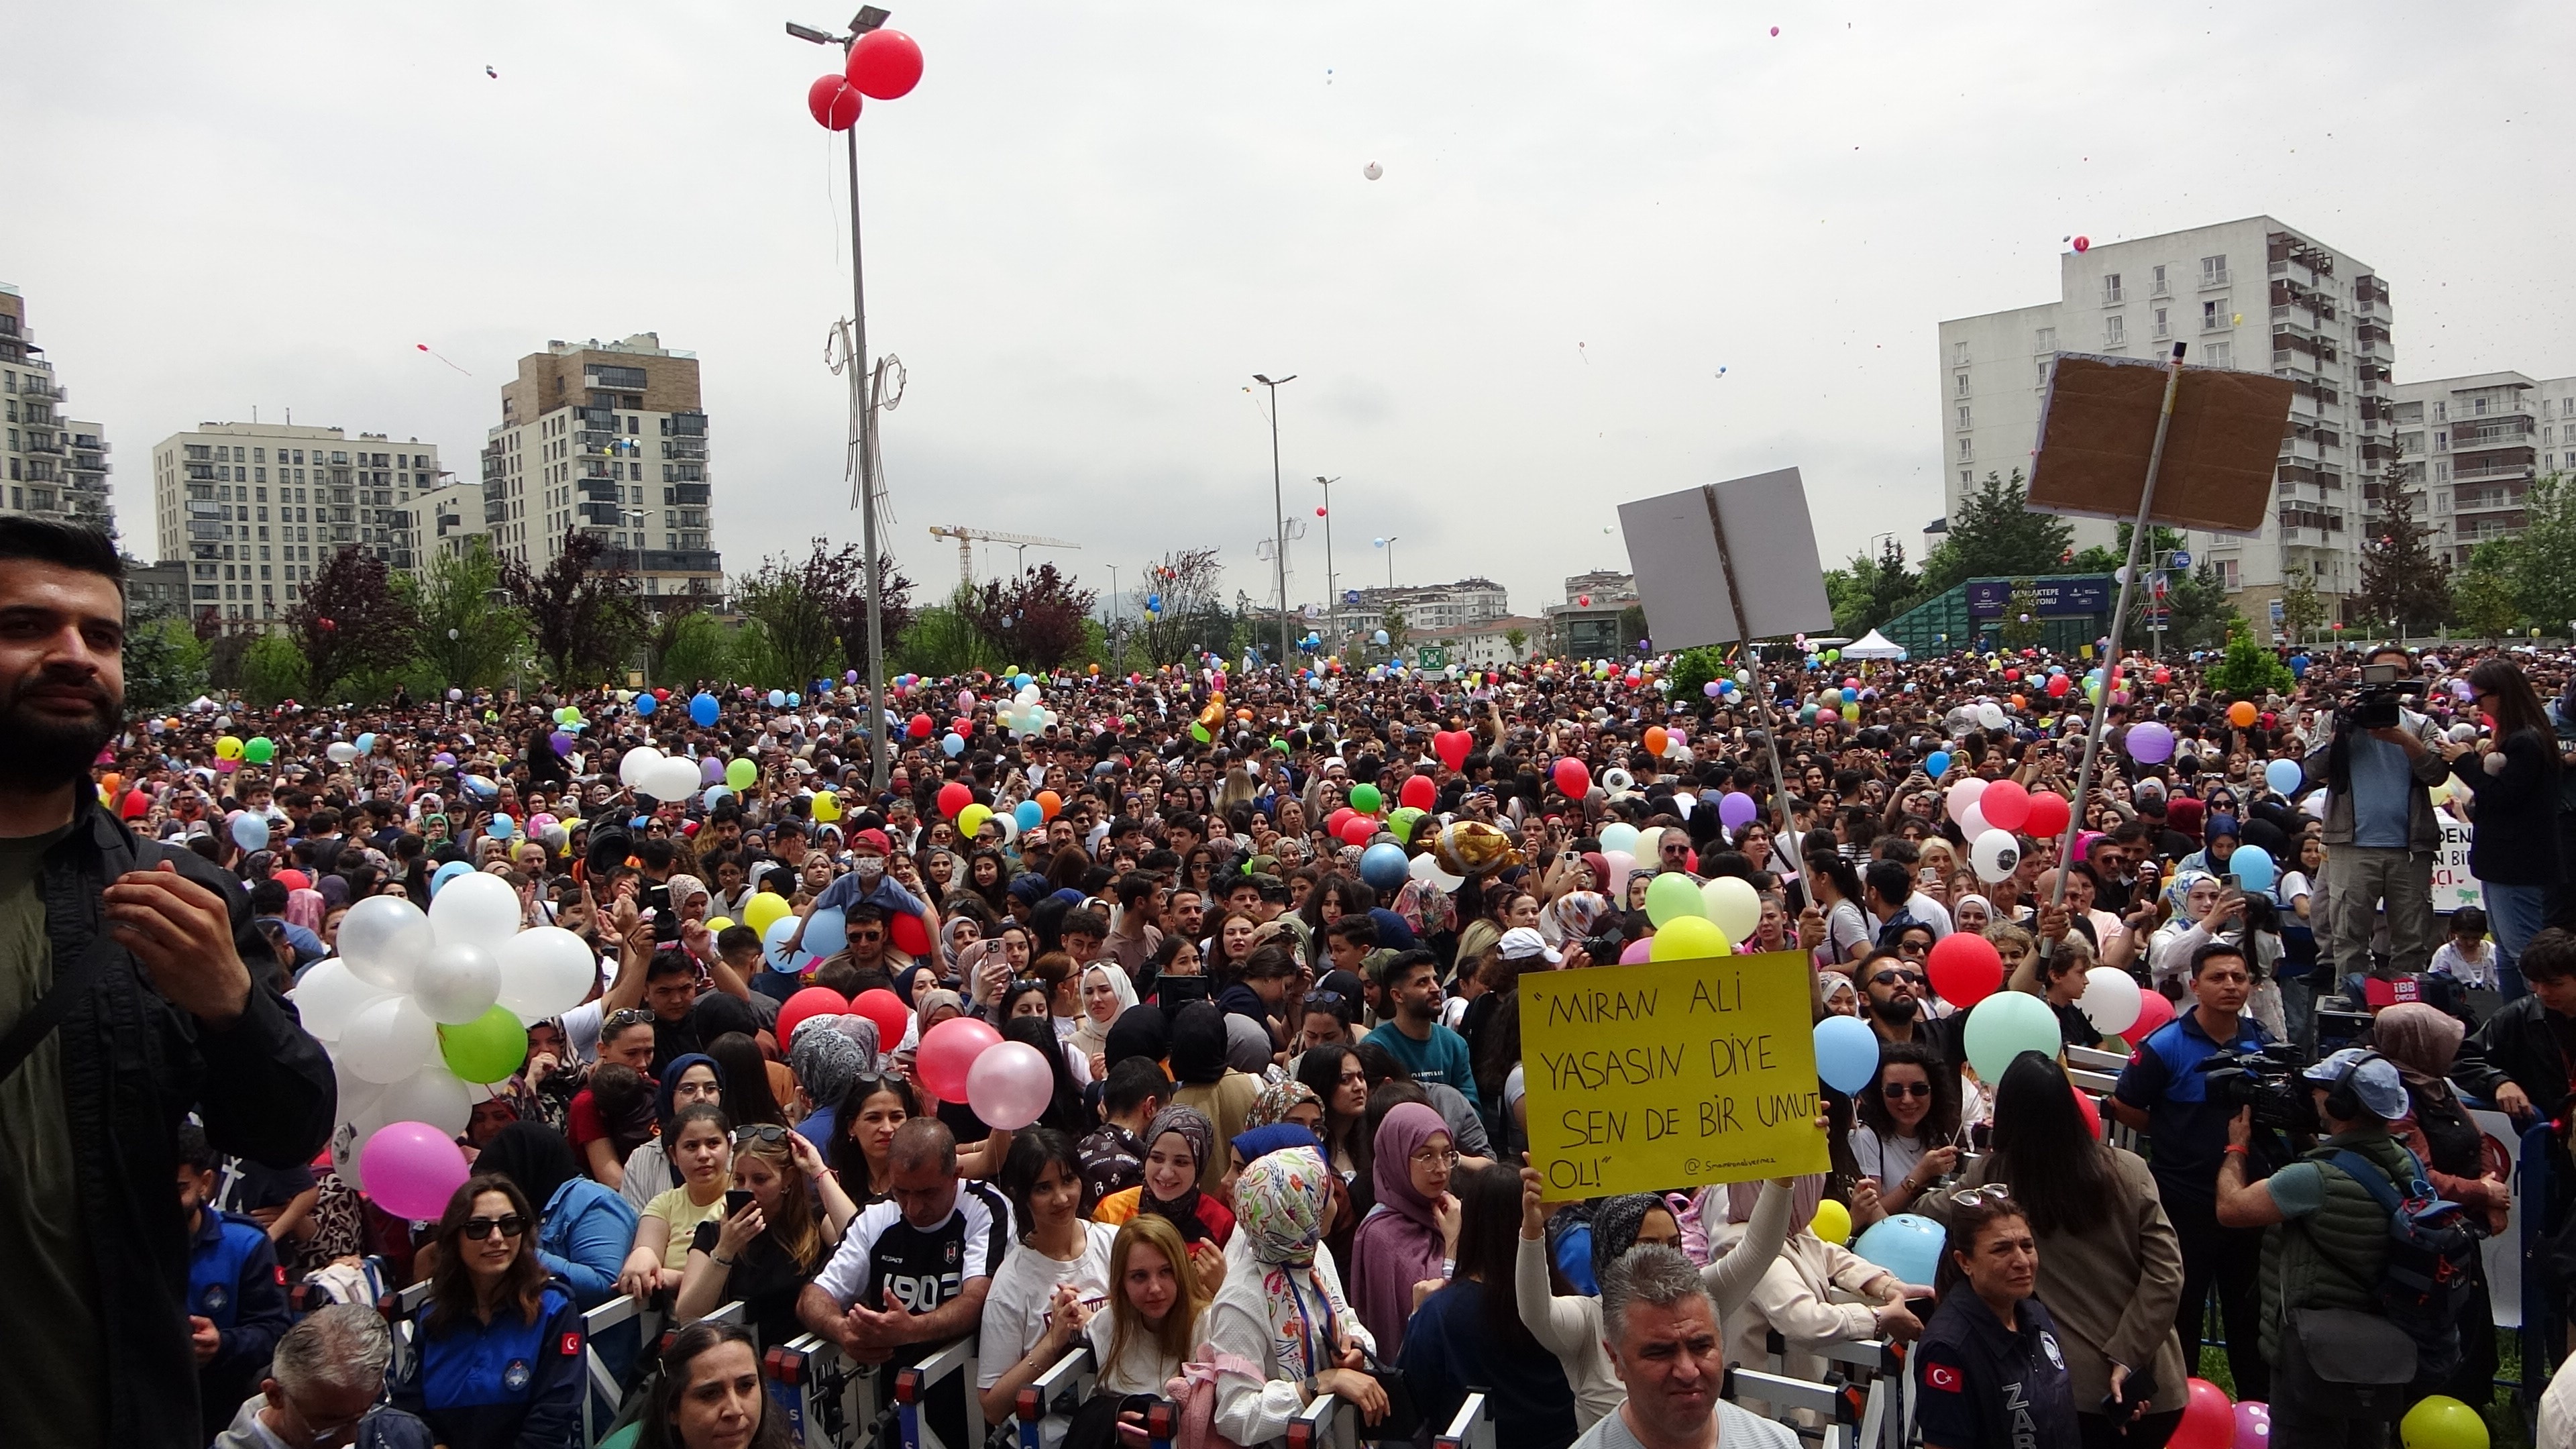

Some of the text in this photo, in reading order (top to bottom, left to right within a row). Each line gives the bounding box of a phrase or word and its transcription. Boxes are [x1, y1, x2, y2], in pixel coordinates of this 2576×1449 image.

[2430, 869, 2452, 889] ÇI
[1689, 971, 1742, 1014] ALİ
[1540, 1032, 1776, 1091] YAŞASIN DİYE
[1560, 1092, 1819, 1149] SEN DE BİR UMUT
[883, 1273, 962, 1312] 1903
